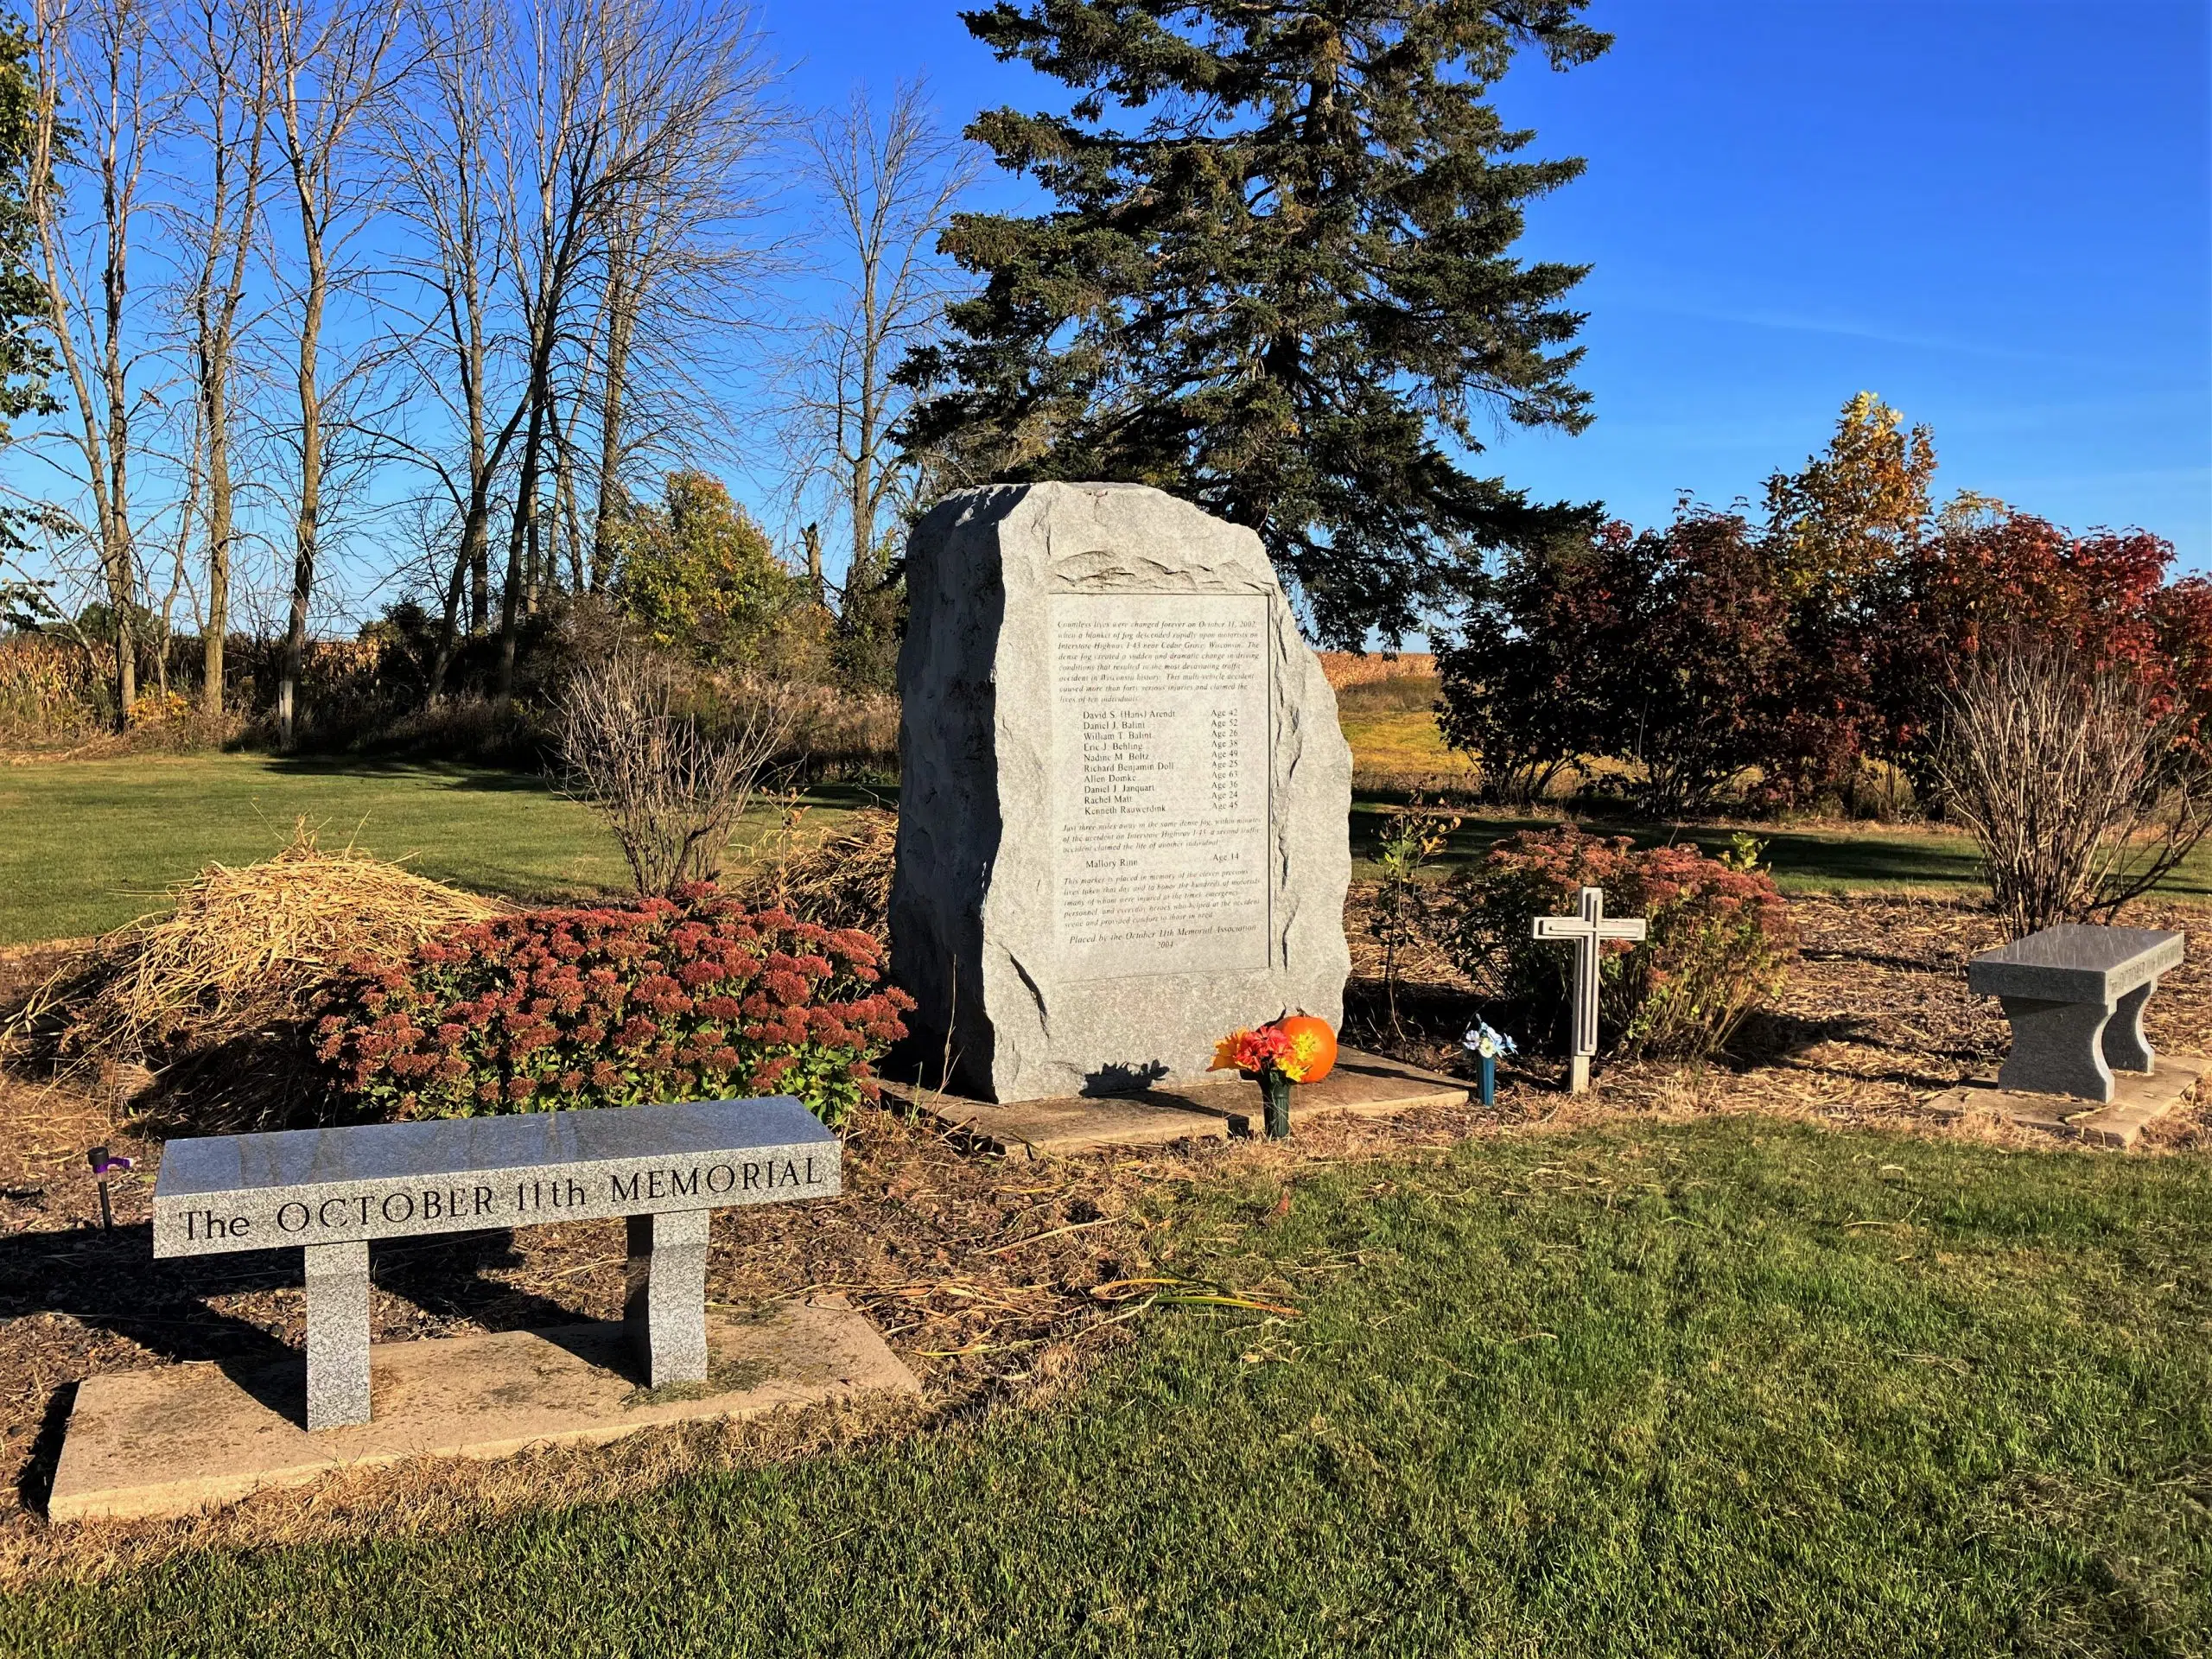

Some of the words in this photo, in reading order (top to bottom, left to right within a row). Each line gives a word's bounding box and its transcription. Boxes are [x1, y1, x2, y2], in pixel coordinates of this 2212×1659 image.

[1149, 710, 1176, 718] Arendt
[1211, 709, 1226, 718] Age
[1211, 720, 1226, 728] Age
[1084, 732, 1115, 740] William
[1212, 730, 1226, 739] Age
[1084, 743, 1099, 751] Eric
[1113, 742, 1143, 751] Behling
[1211, 740, 1226, 749] Age
[1212, 751, 1226, 760] Age
[1084, 764, 1115, 772] Richard
[1117, 763, 1154, 772] Benjamin
[1158, 762, 1174, 770] Doll
[1212, 761, 1227, 770] Age
[1084, 775, 1105, 783] Allen
[1109, 774, 1137, 782] Domke
[1212, 771, 1226, 780] Age
[1084, 785, 1109, 794] Daniel
[1122, 784, 1155, 793] Janquart
[1211, 782, 1226, 790] Age
[1084, 795, 1111, 804] Rachel
[1114, 795, 1132, 803] Matt
[1212, 791, 1227, 801] Age
[1085, 806, 1117, 815] Kenneth
[1212, 802, 1227, 810] Age
[1086, 859, 1116, 868] Mallory
[1213, 854, 1227, 863] Age
[1070, 935, 1096, 944] Placed
[1126, 931, 1156, 940] October
[1178, 926, 1212, 935] Memorial
[179, 1210, 249, 1241] The
[276, 1185, 493, 1234] OCTOBER
[517, 1176, 586, 1210] 11th
[610, 1156, 823, 1203] MEMORIAL
